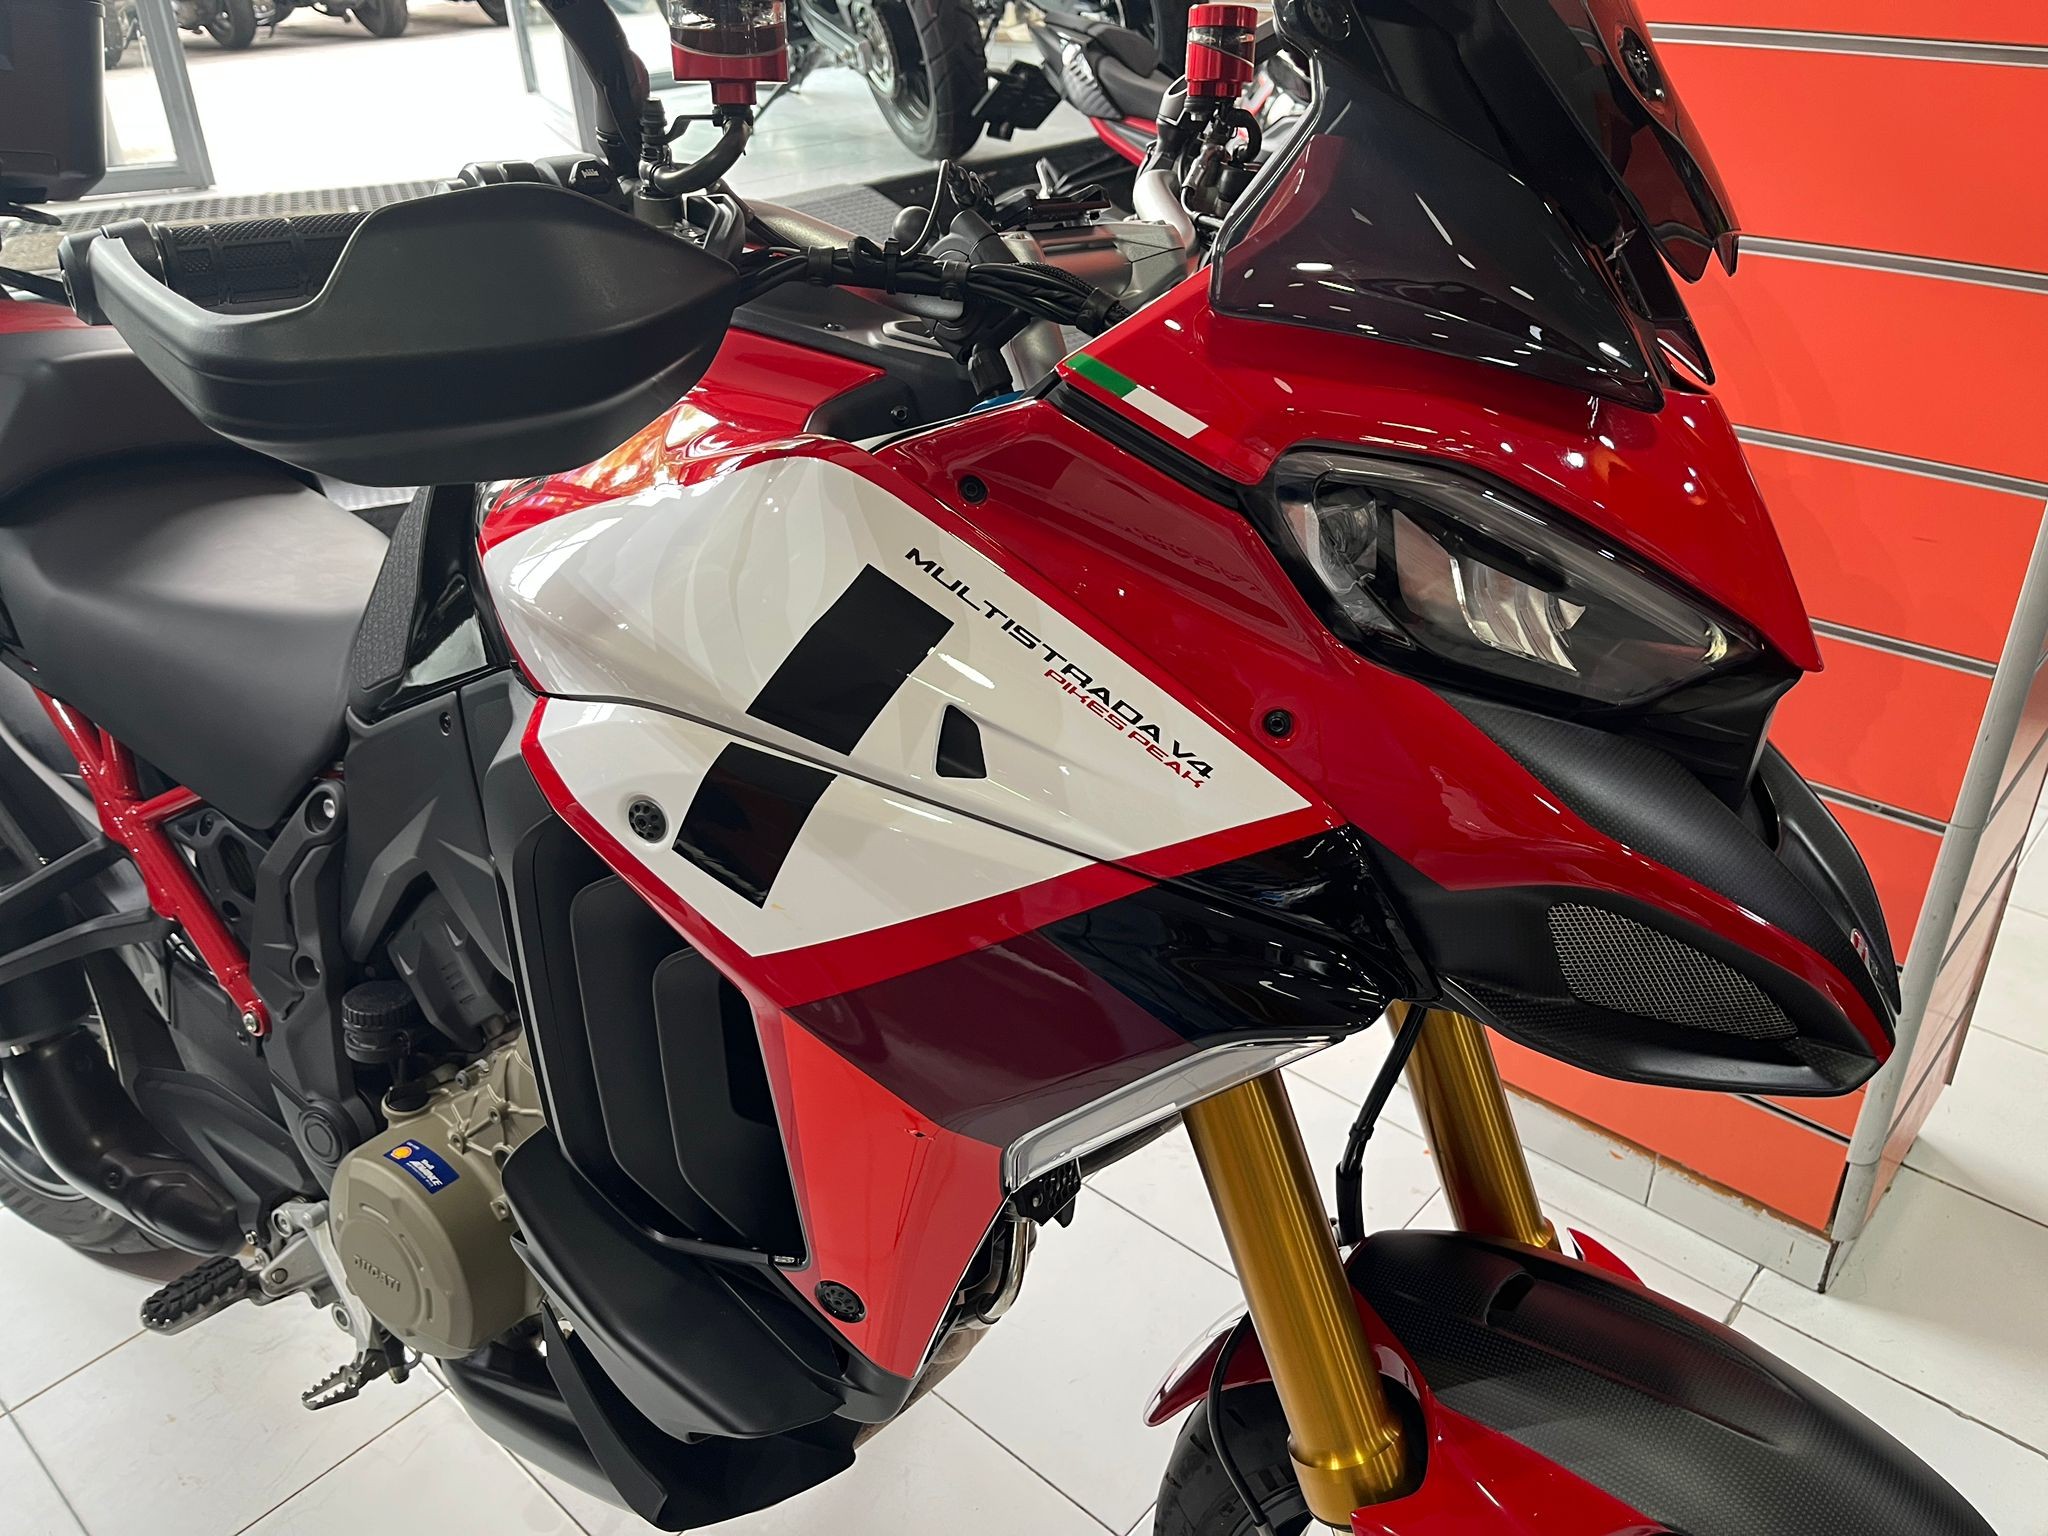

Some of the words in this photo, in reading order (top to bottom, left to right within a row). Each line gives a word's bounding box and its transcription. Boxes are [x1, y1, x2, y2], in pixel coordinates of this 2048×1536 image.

[904, 547, 1161, 744] MULTISTRADA
[1171, 740, 1214, 780] V4
[1043, 669, 1128, 732] PIKES
[1127, 730, 1205, 789] PEAK
